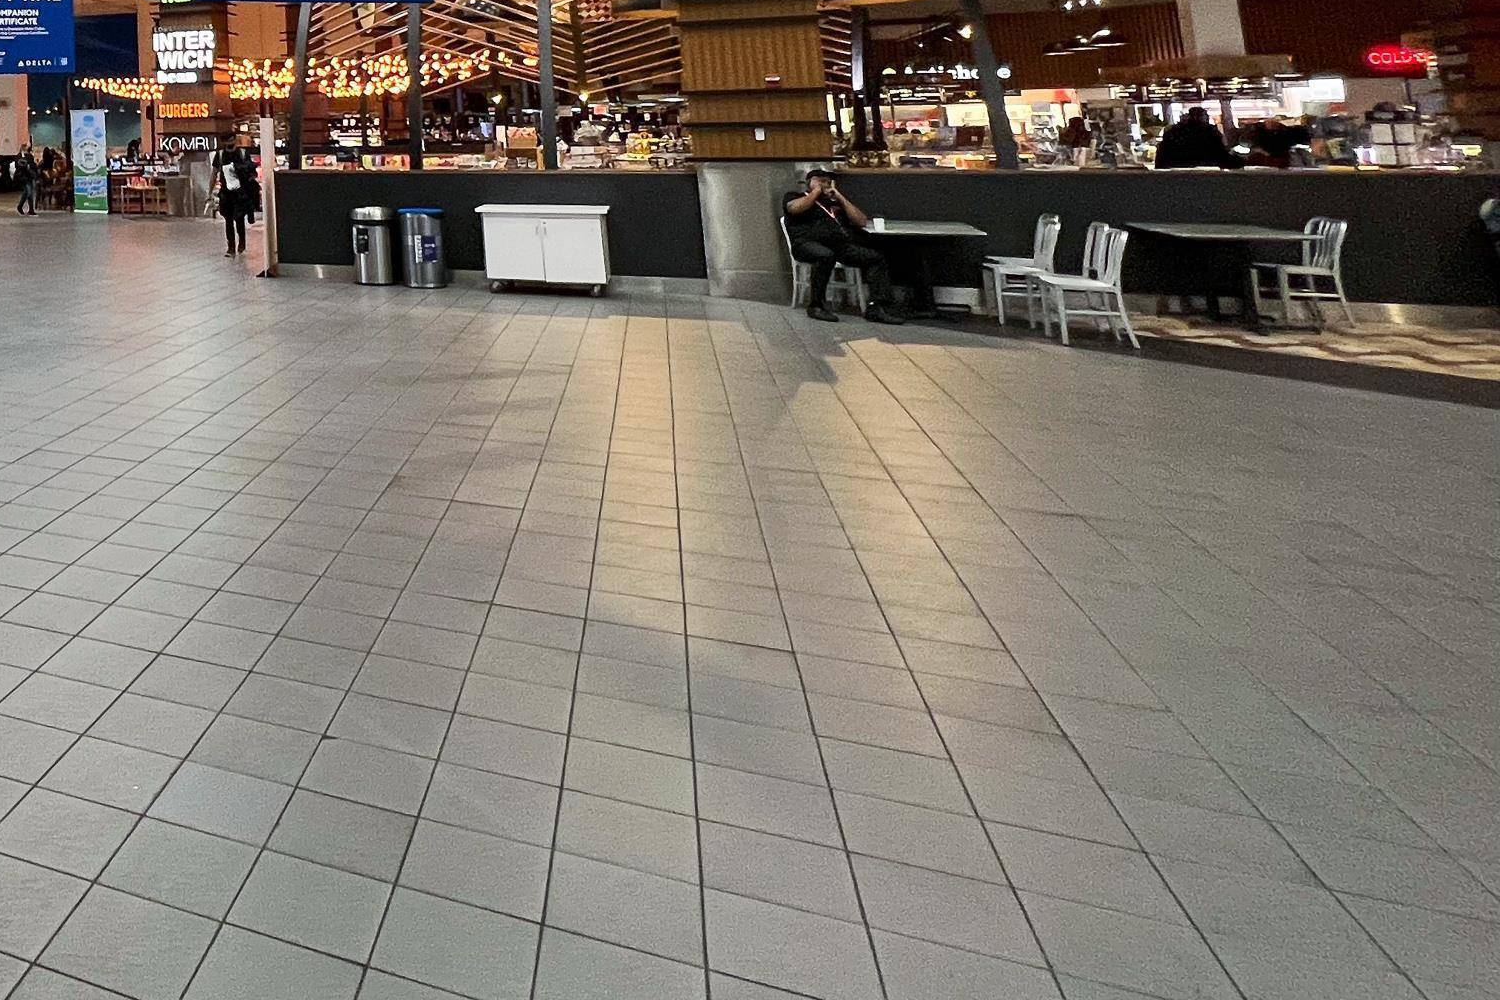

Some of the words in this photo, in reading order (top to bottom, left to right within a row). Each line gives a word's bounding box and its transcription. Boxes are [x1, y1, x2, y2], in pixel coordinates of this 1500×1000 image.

[153, 31, 216, 51] INTER
[157, 50, 214, 70] WICH
[158, 103, 209, 118] BURGERS
